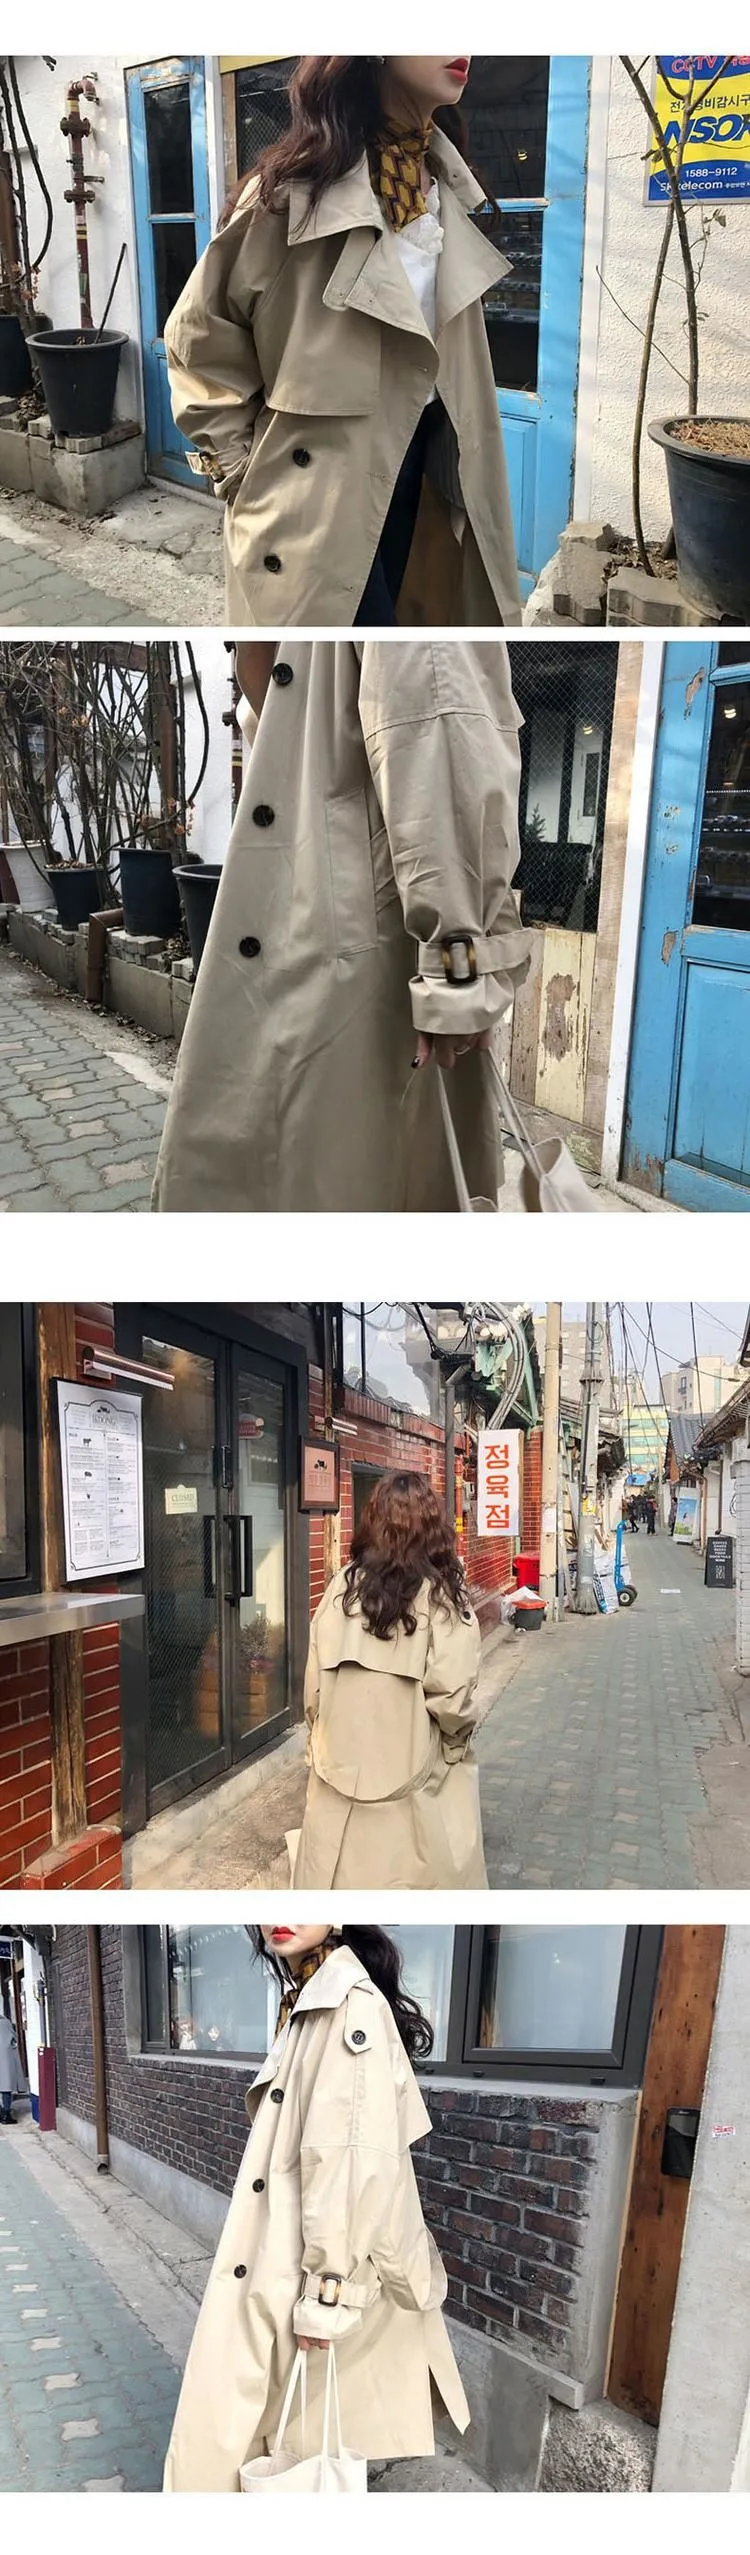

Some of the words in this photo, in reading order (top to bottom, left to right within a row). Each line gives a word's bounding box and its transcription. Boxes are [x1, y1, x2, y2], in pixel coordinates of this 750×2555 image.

[671, 56, 717, 73] CCTV
[670, 94, 750, 113] 전비감시구
[685, 166, 738, 178] 1588-9112
[484, 1444, 510, 1528] 정육점
